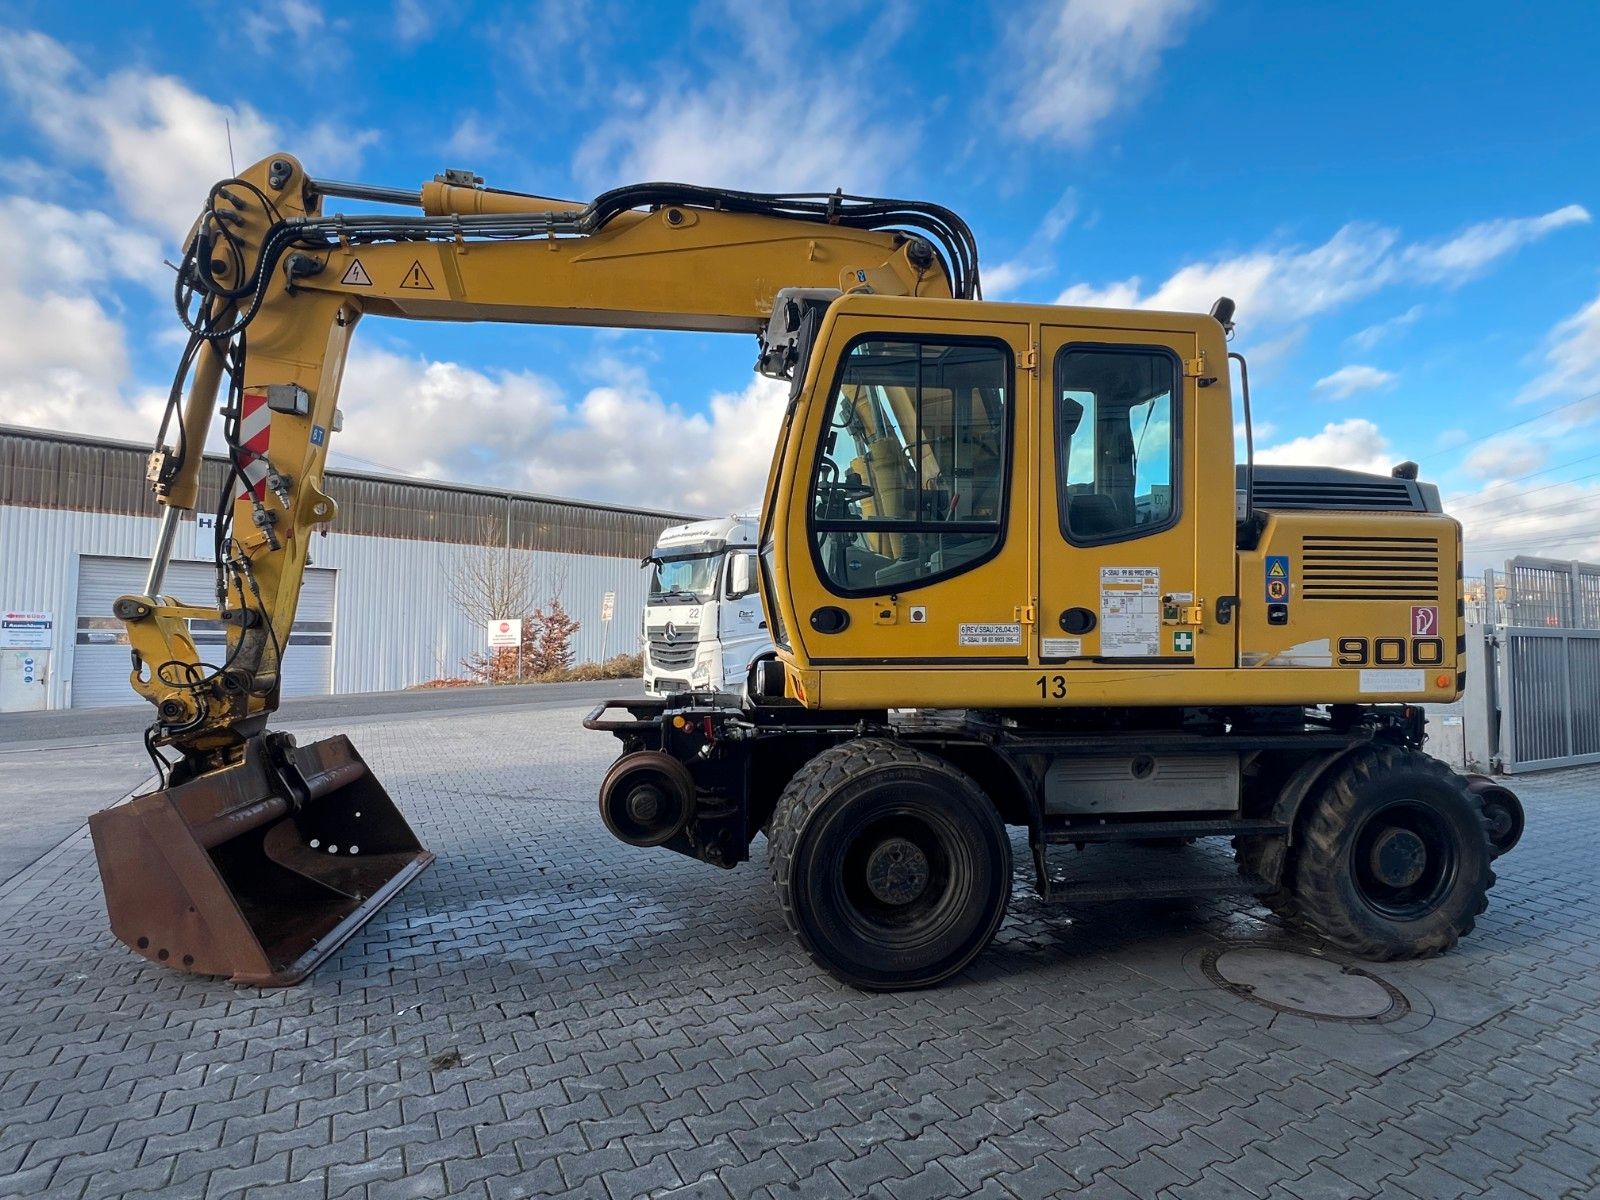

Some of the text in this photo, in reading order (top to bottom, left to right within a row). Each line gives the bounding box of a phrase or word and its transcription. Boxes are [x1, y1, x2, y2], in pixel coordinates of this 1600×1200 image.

[688, 608, 700, 619] 22
[1337, 637, 1444, 666] 900
[1035, 675, 1067, 699] 13
